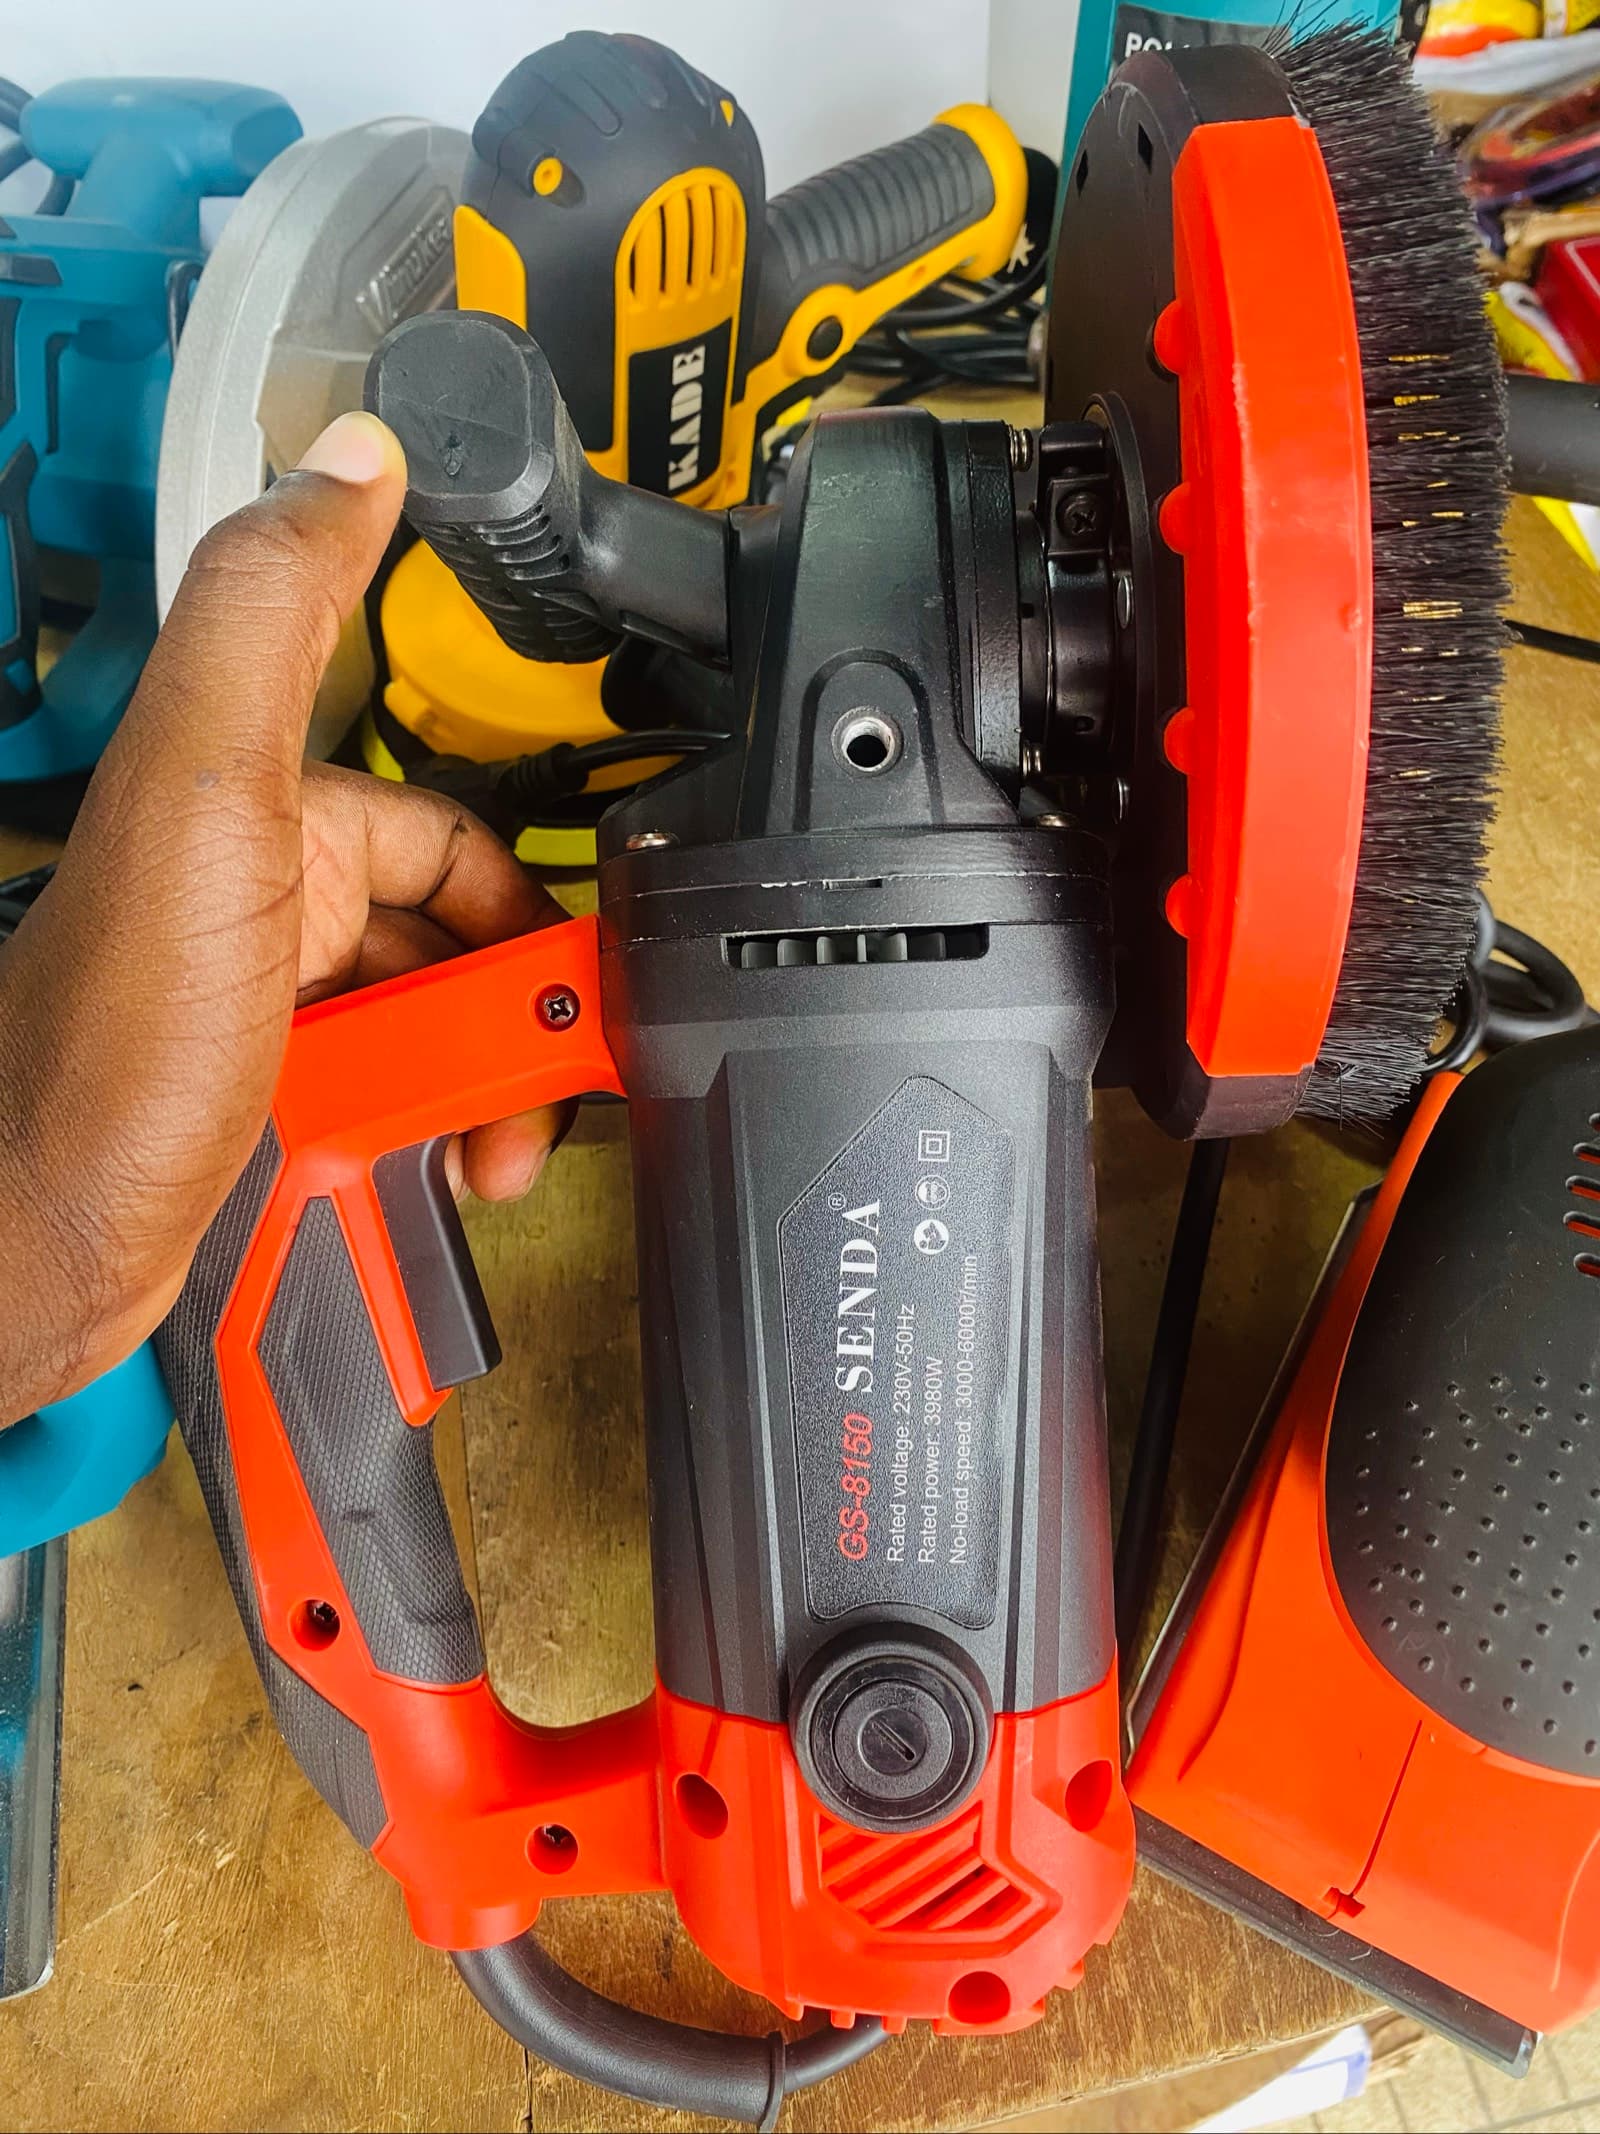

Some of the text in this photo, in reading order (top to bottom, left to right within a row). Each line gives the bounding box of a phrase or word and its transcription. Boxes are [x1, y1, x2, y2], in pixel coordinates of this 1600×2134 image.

[835, 1199, 880, 1393] SENDA
[838, 1412, 873, 1560] GS-8150
[887, 1303, 915, 1562] Rated voltage: 230V-50Hz
[918, 1356, 944, 1563] Rated power: 3980W
[949, 1255, 978, 1564] No-load speed: 3000-6000r/min
